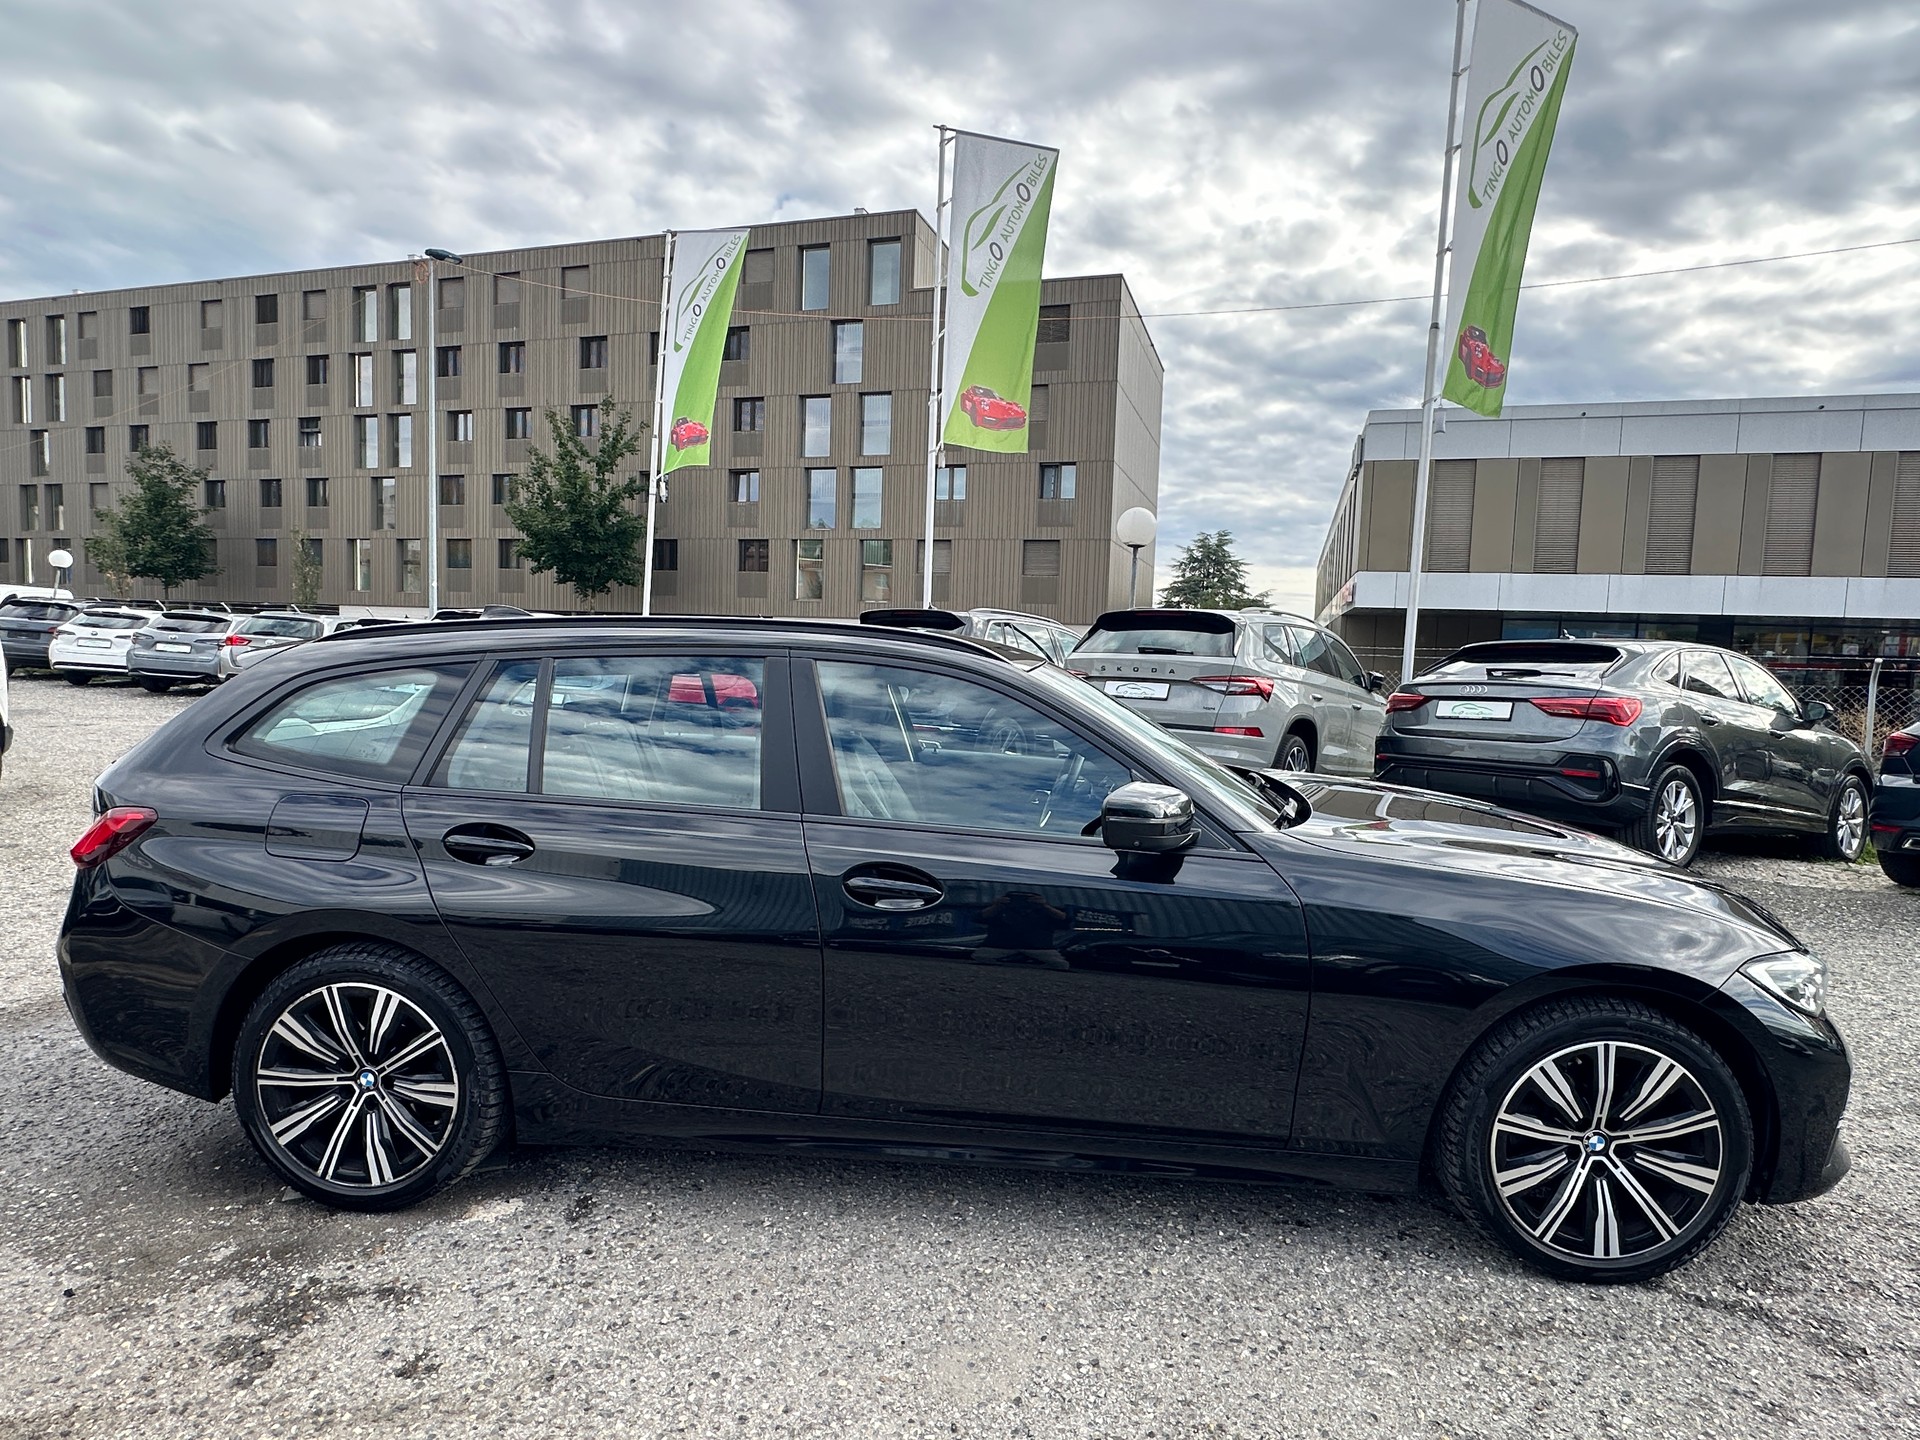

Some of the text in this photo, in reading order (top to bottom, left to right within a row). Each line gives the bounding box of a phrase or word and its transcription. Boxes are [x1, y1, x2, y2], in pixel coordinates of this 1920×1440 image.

[1483, 29, 1568, 200] TINGO AUTOMOBILES
[978, 153, 1048, 288] TINGO AUTOMOBILES
[683, 234, 741, 342] TINGO AUTOMOBILES
[1100, 665, 1176, 675] SKODA
